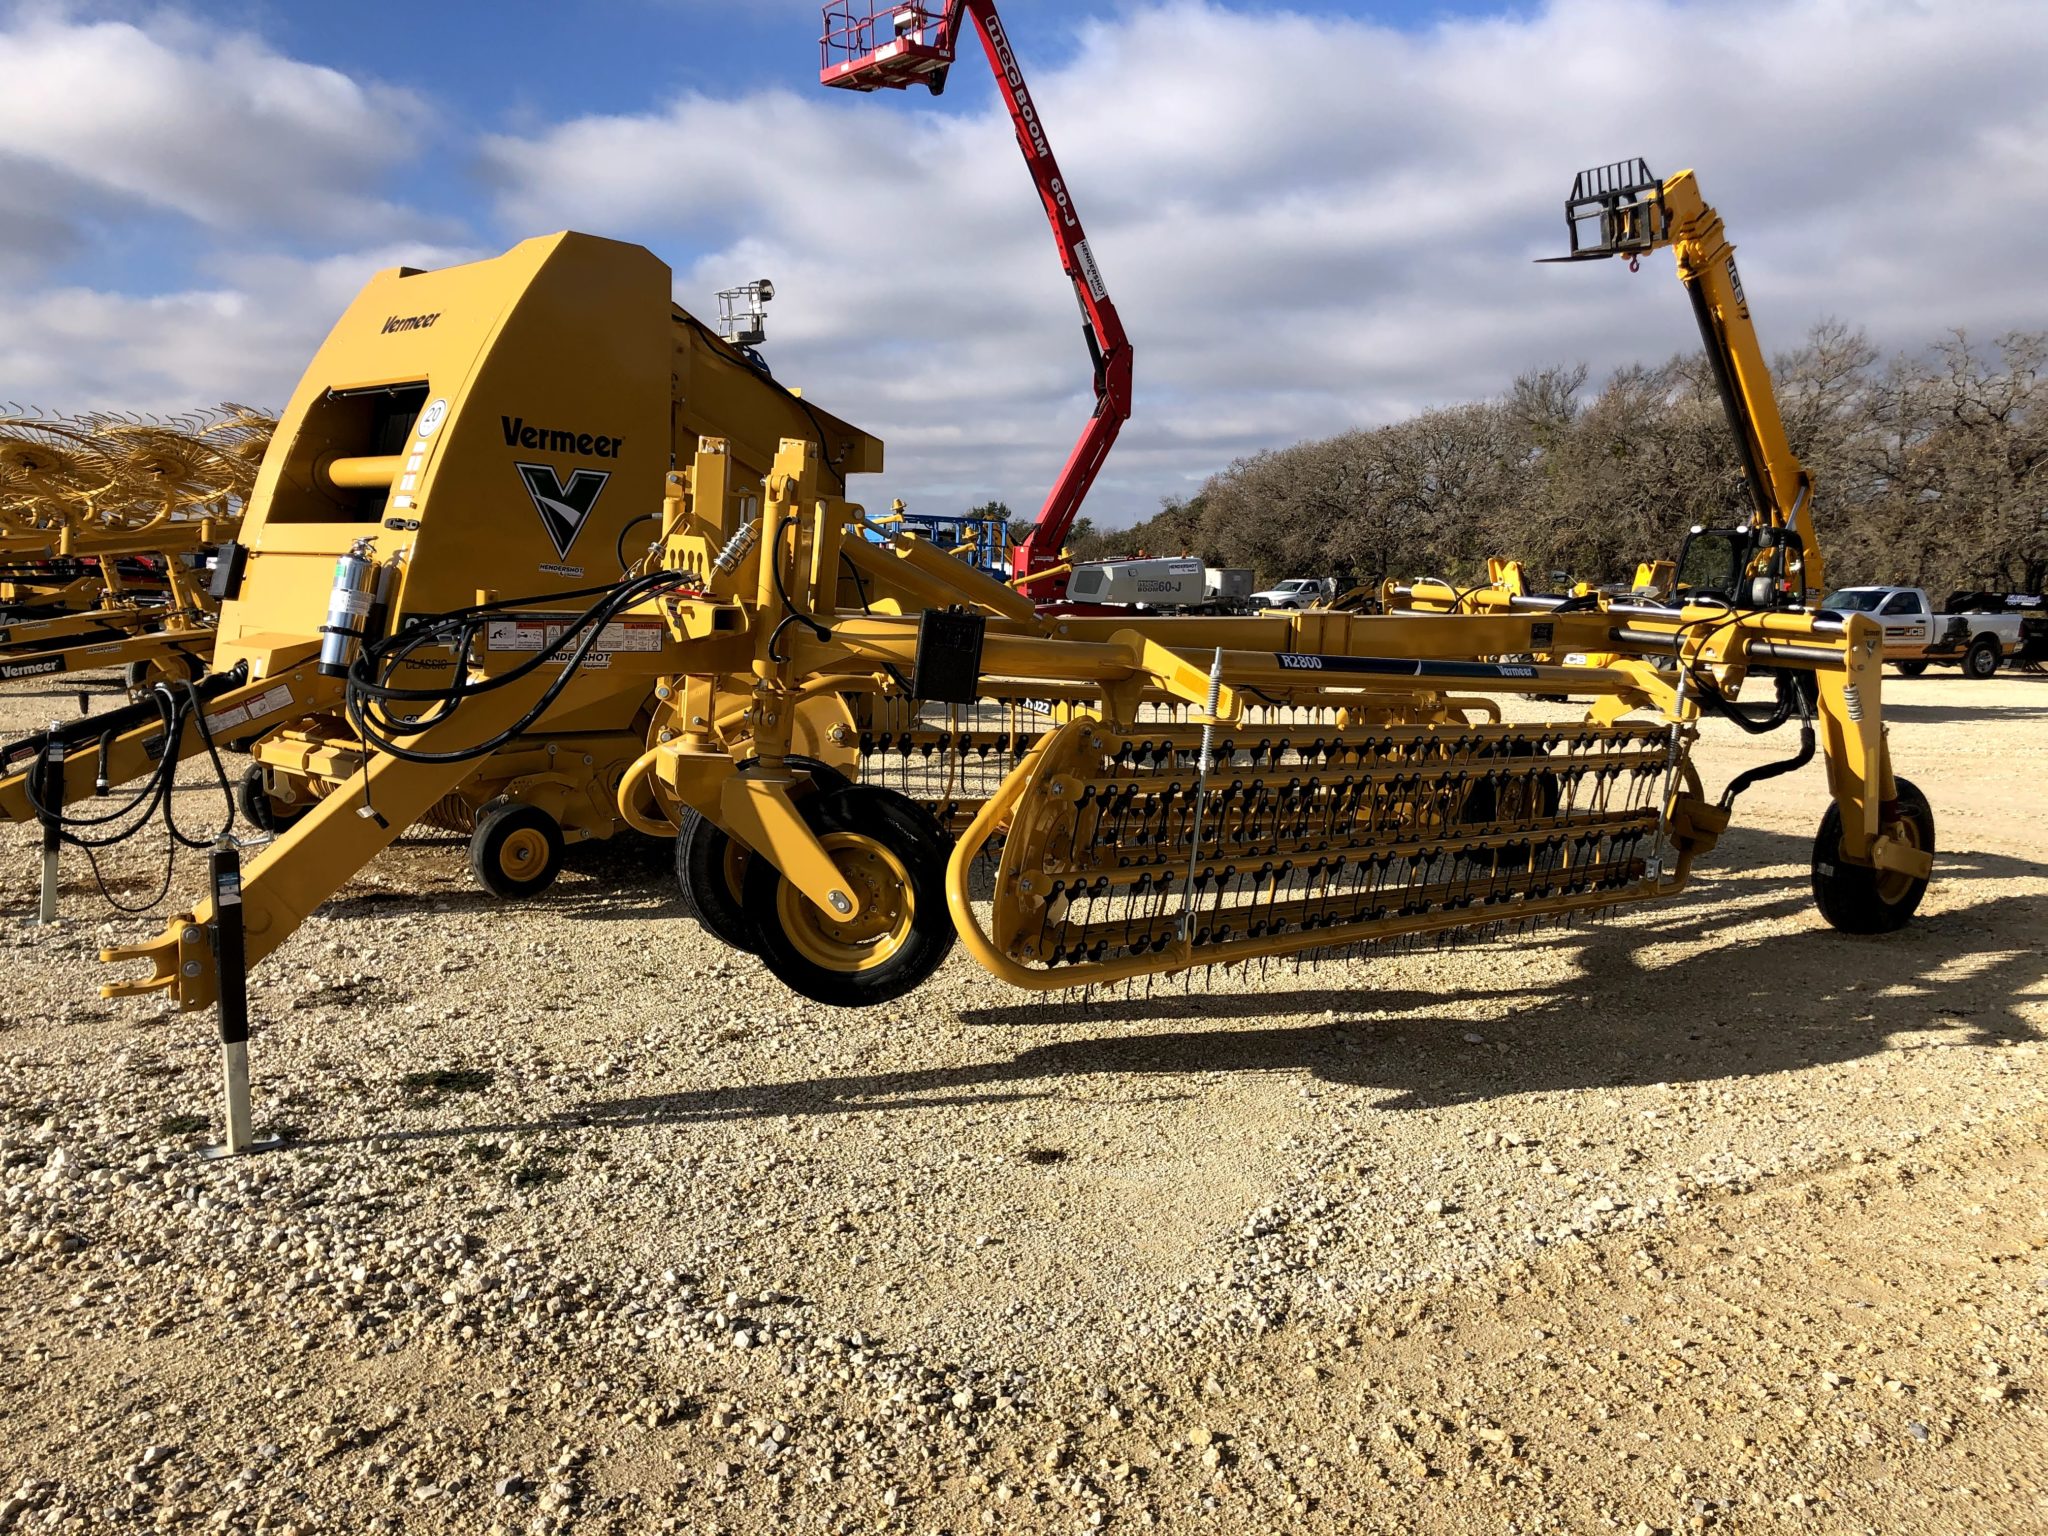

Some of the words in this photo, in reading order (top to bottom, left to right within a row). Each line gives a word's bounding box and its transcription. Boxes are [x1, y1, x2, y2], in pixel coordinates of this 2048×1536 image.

[1015, 88, 1048, 158] BOOM
[1051, 178, 1076, 227] 60-J
[1080, 241, 1106, 297] HENDERSHOT
[1726, 256, 1744, 304] JCB
[381, 313, 441, 334] Vermeer
[425, 406, 442, 422] 20
[501, 415, 623, 459] Vermeer
[540, 564, 583, 573] HENDERSHOT
[1158, 581, 1181, 592] 60-J
[1906, 627, 1925, 636] JCB
[1, 661, 56, 678] Vermeer
[1281, 655, 1322, 669] R2800
[1496, 665, 1532, 676] Vermeer
